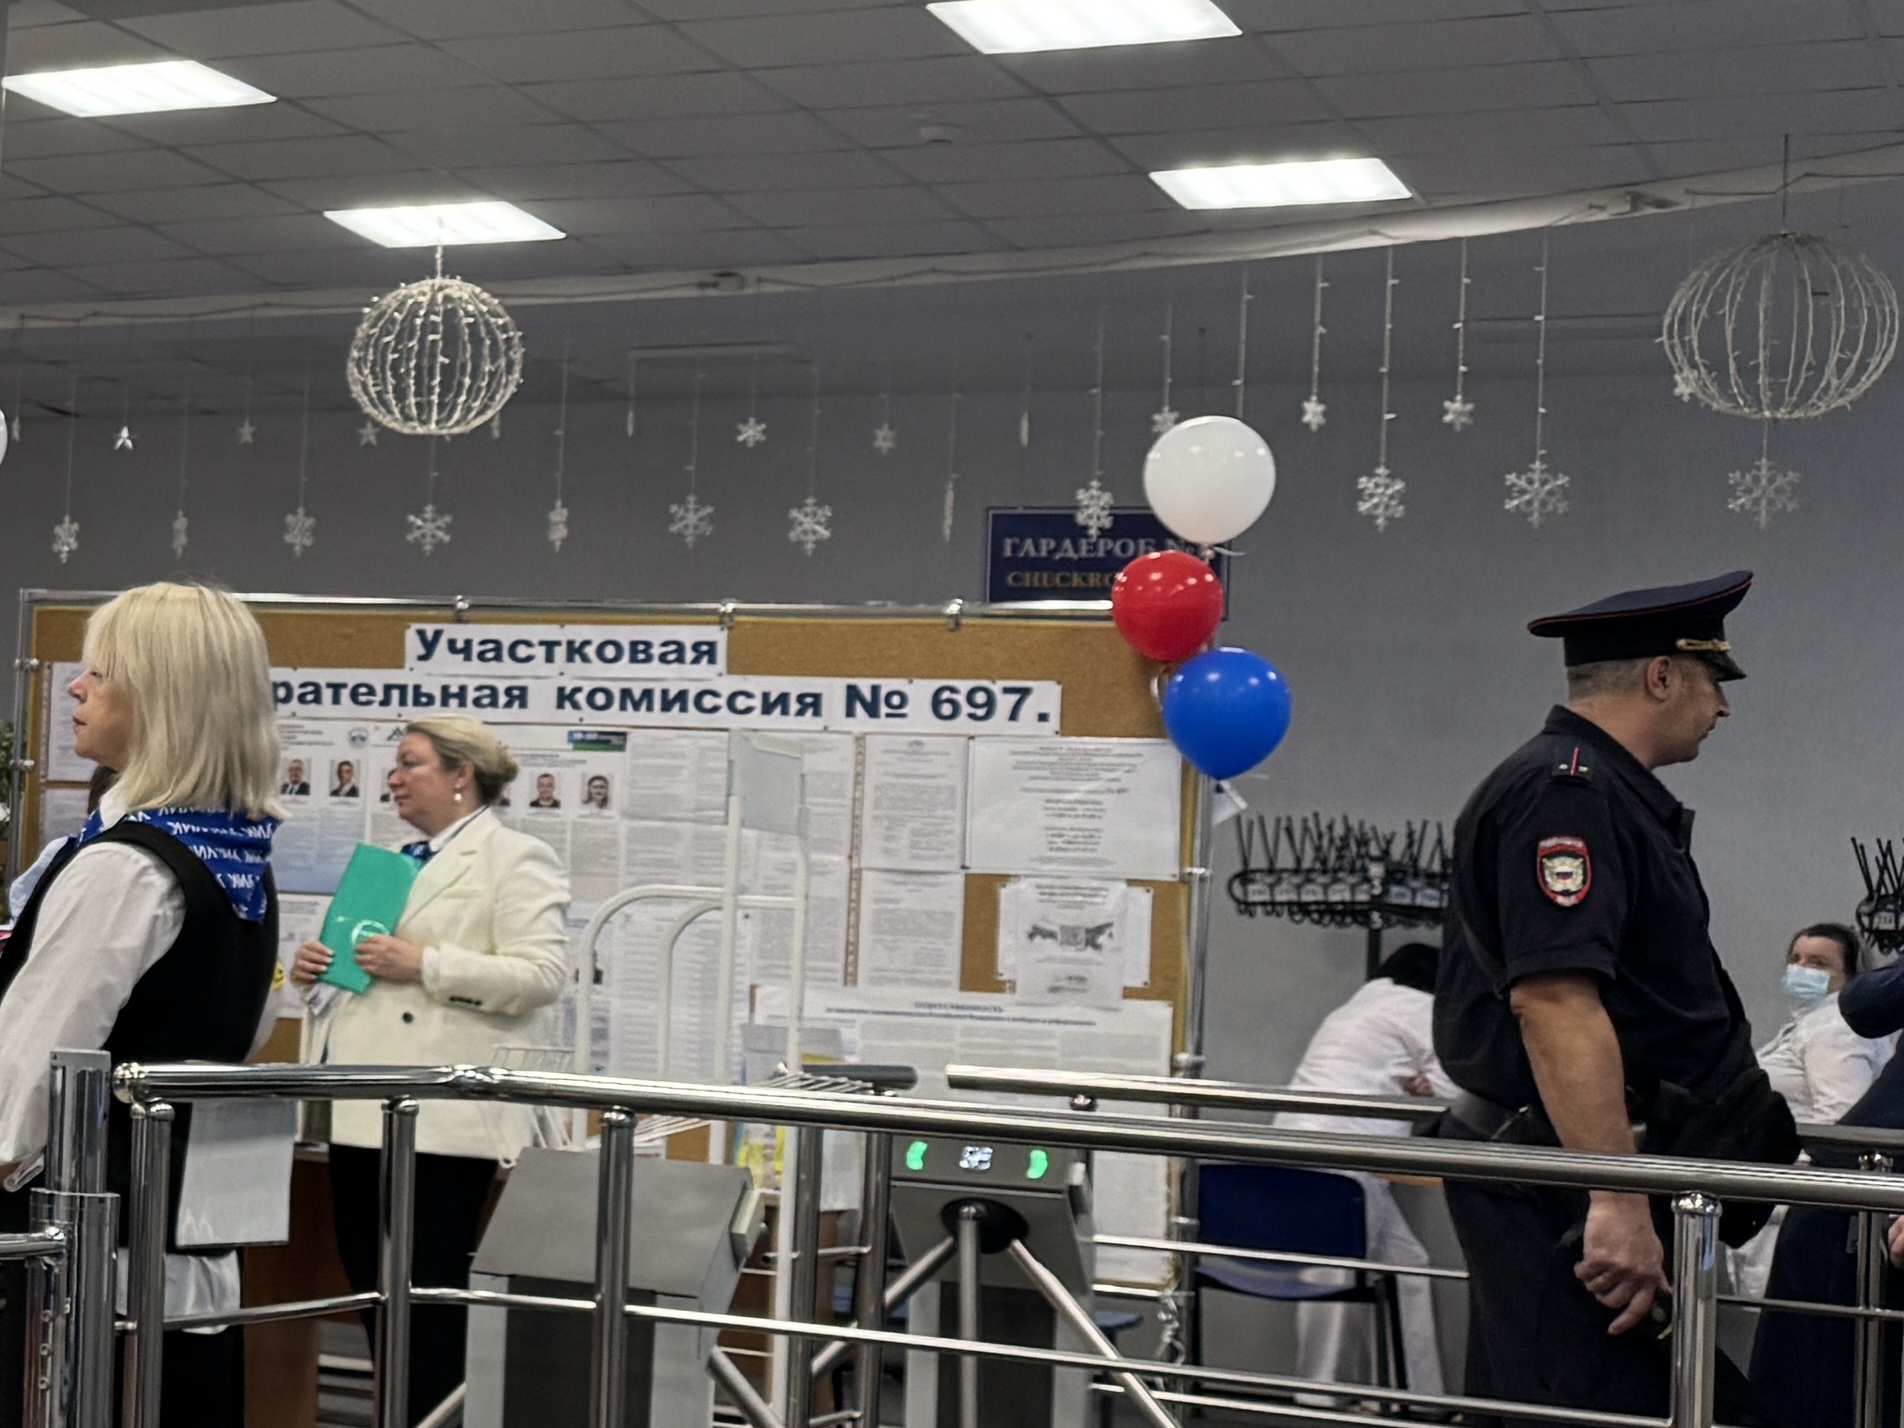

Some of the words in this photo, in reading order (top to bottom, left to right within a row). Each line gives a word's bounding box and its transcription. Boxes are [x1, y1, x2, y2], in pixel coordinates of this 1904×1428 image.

[415, 628, 719, 666] Участковая
[272, 681, 529, 710] рательная
[556, 686, 823, 718] комиссия
[845, 683, 909, 719] №
[931, 685, 1050, 723] 697.
